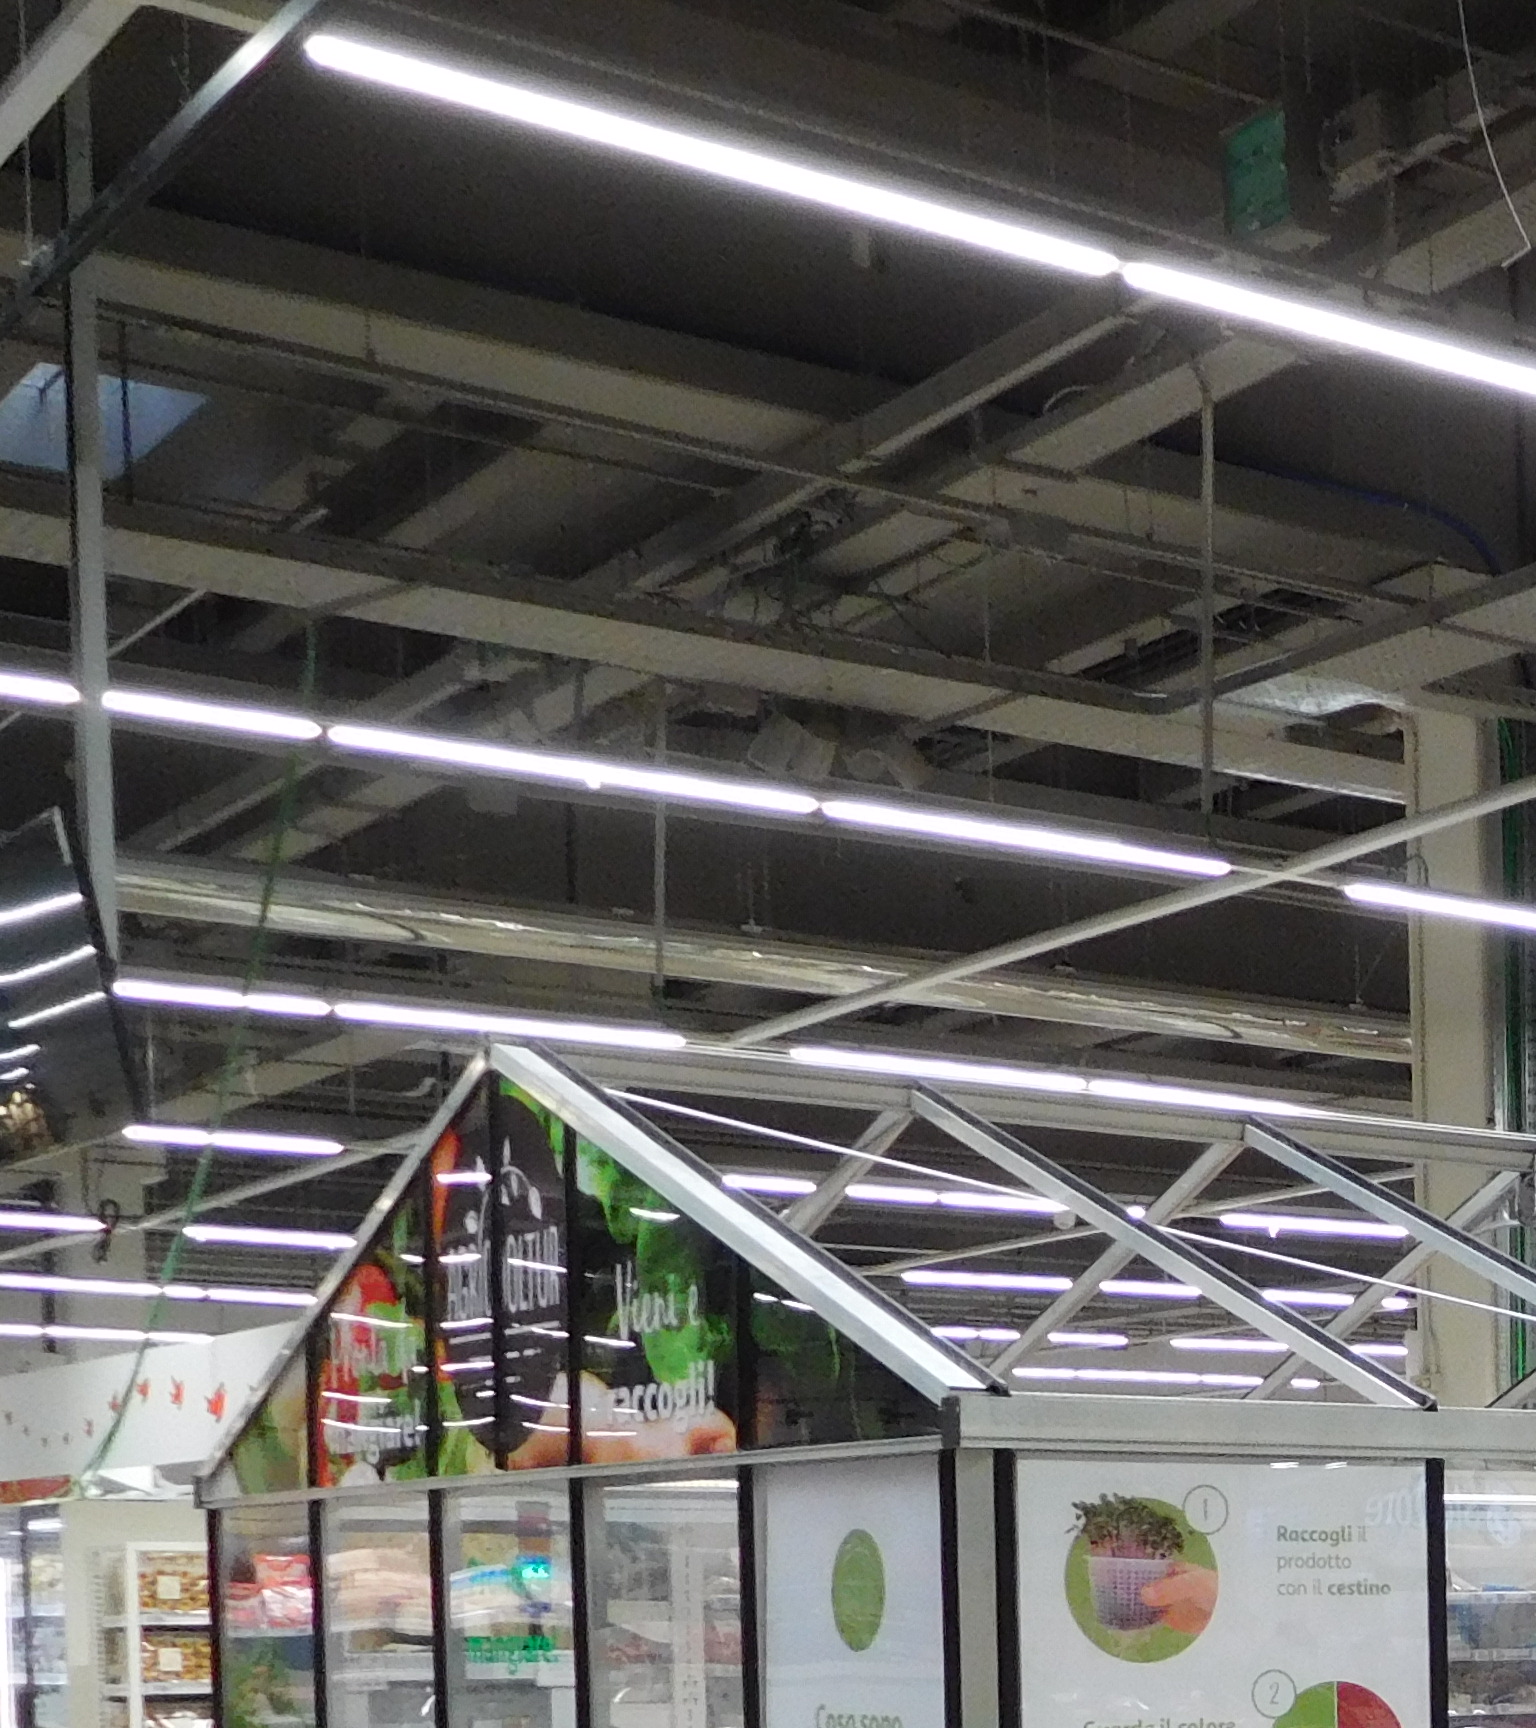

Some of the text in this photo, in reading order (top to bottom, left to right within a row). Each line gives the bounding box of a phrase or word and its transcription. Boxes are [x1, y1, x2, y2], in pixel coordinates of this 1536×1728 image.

[687, 1283, 700, 1327] e
[1276, 1525, 1368, 1546] Raccogli il
[1276, 1551, 1352, 1575] prodotto
[1276, 1578, 1392, 1597] con il cestino
[1269, 1682, 1281, 1705] 2
